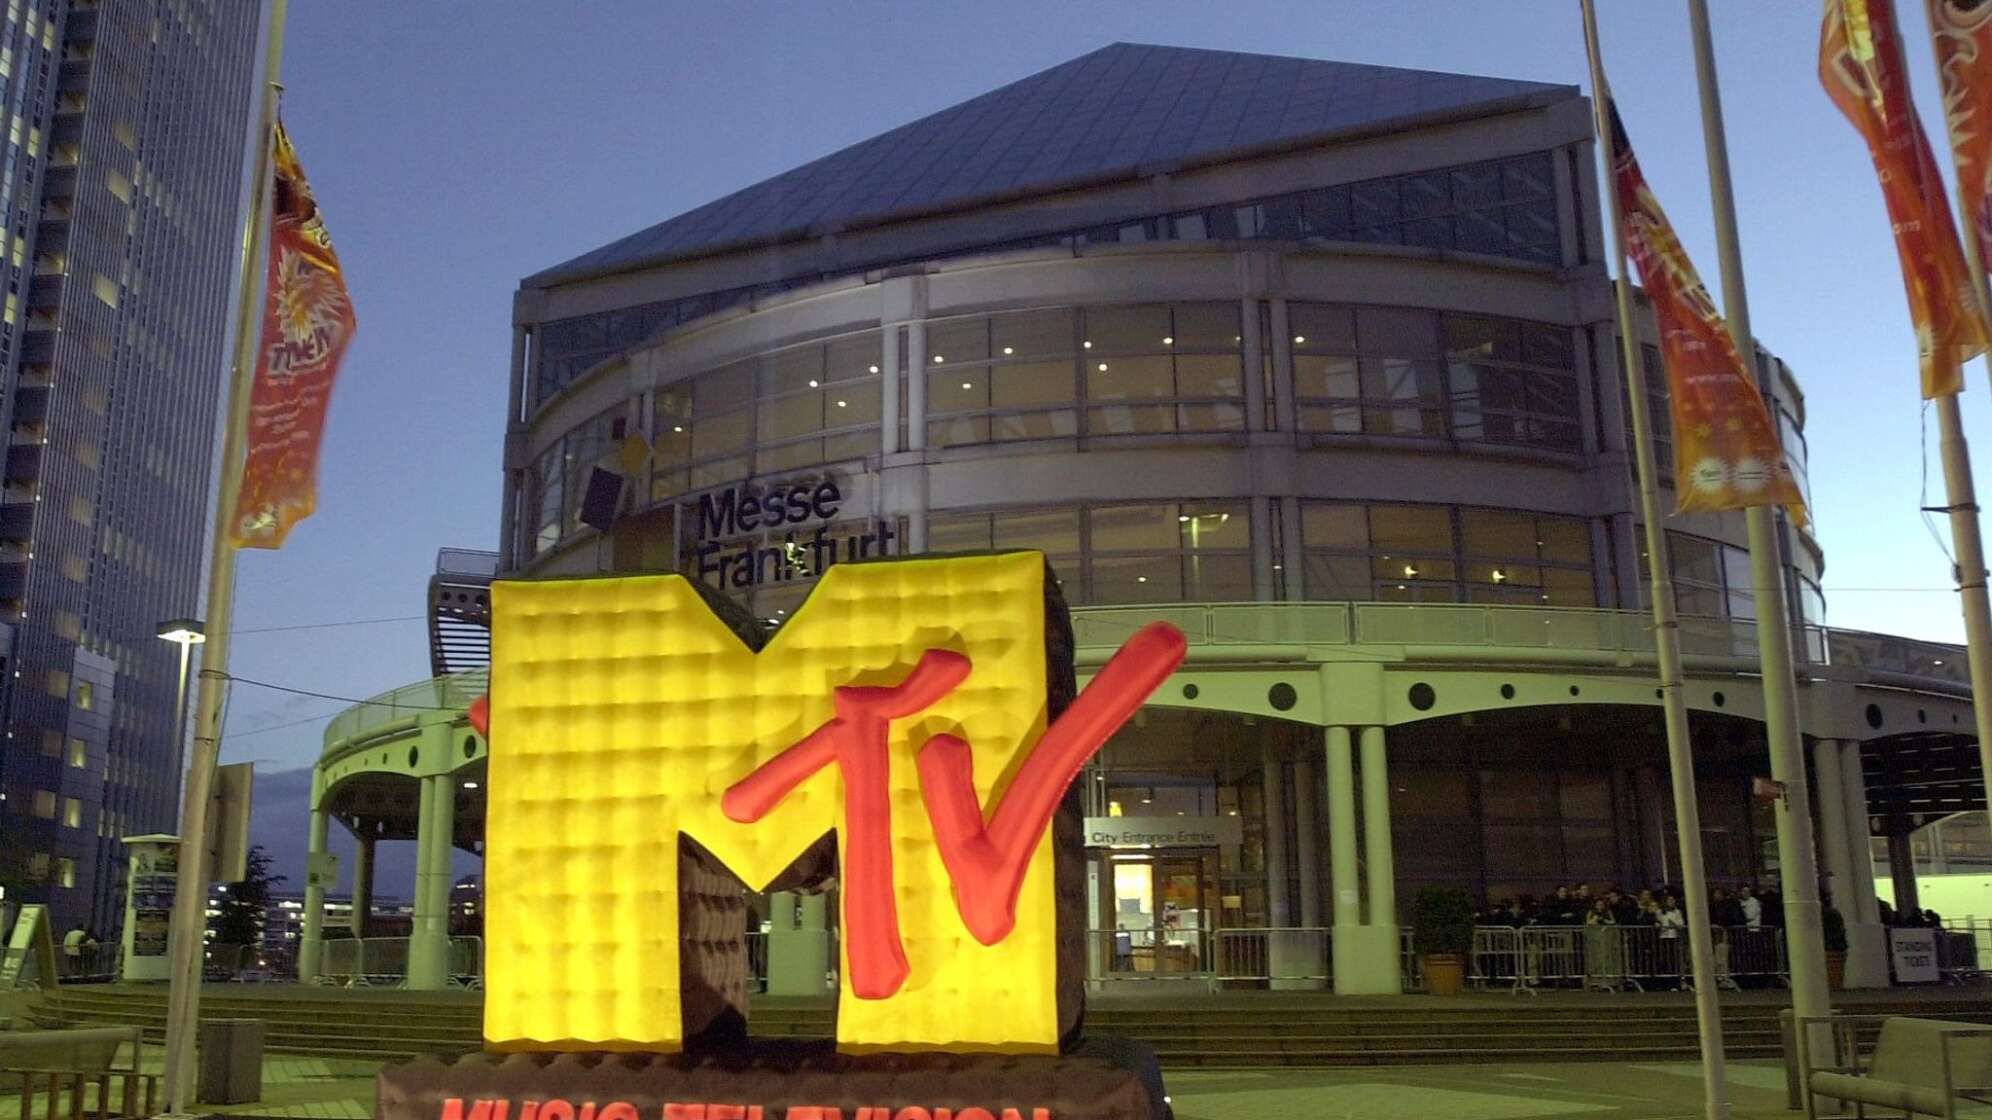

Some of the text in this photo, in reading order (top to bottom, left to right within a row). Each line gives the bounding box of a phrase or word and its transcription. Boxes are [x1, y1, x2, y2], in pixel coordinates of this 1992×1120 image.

[699, 482, 841, 539] Messe
[1092, 831, 1118, 844] City
[1123, 831, 1173, 843] Entrance
